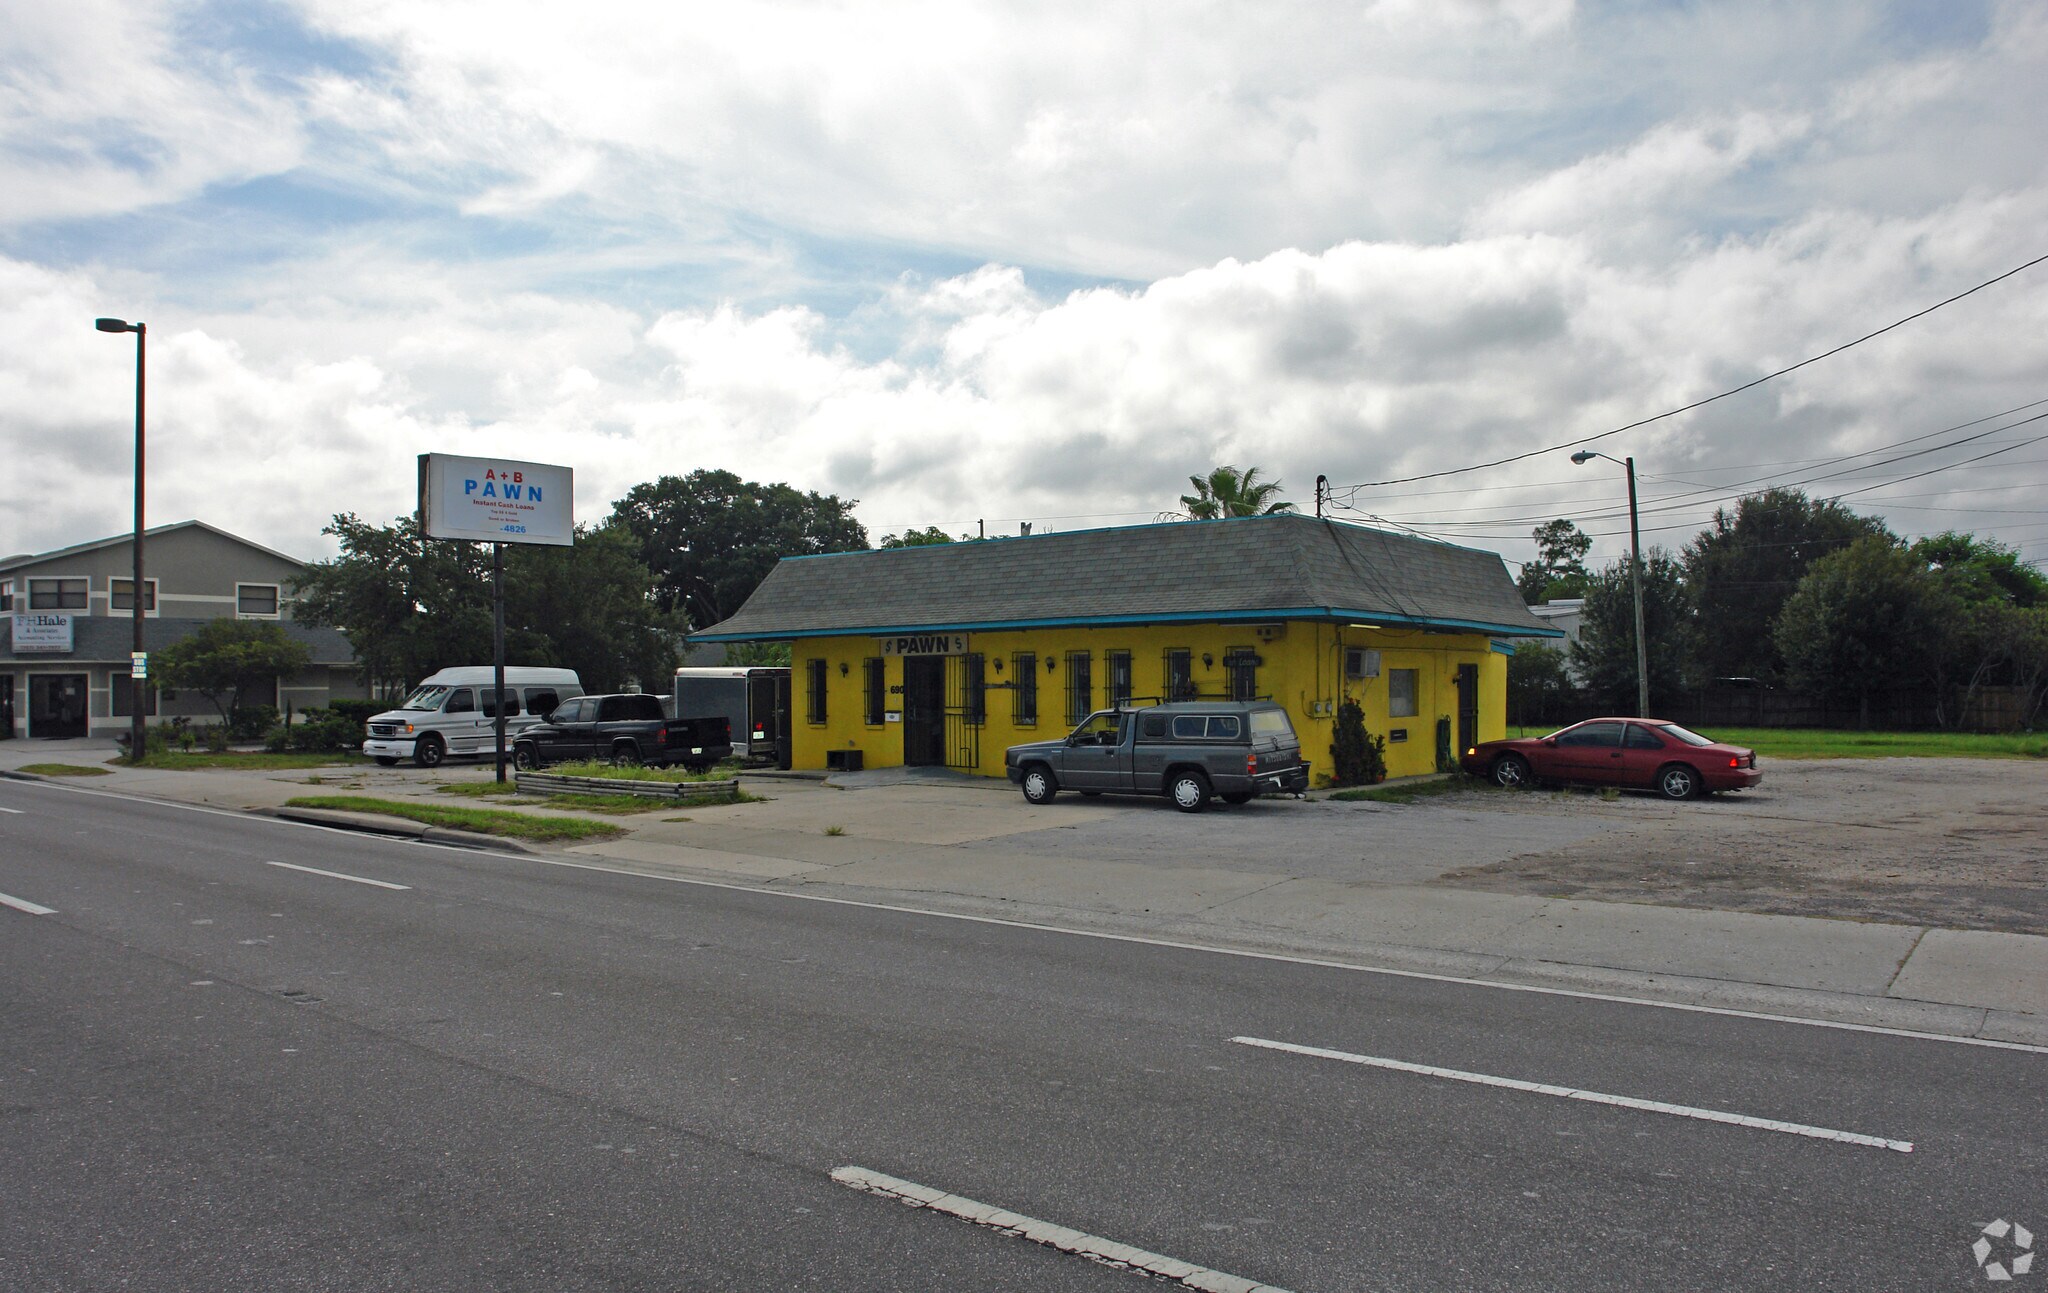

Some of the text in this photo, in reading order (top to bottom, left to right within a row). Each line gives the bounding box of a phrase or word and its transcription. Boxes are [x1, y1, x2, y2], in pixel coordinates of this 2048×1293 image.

[465, 479, 542, 502] PAWN
[473, 499, 535, 511] Instant Cash Loans
[896, 636, 949, 654] PAWN
